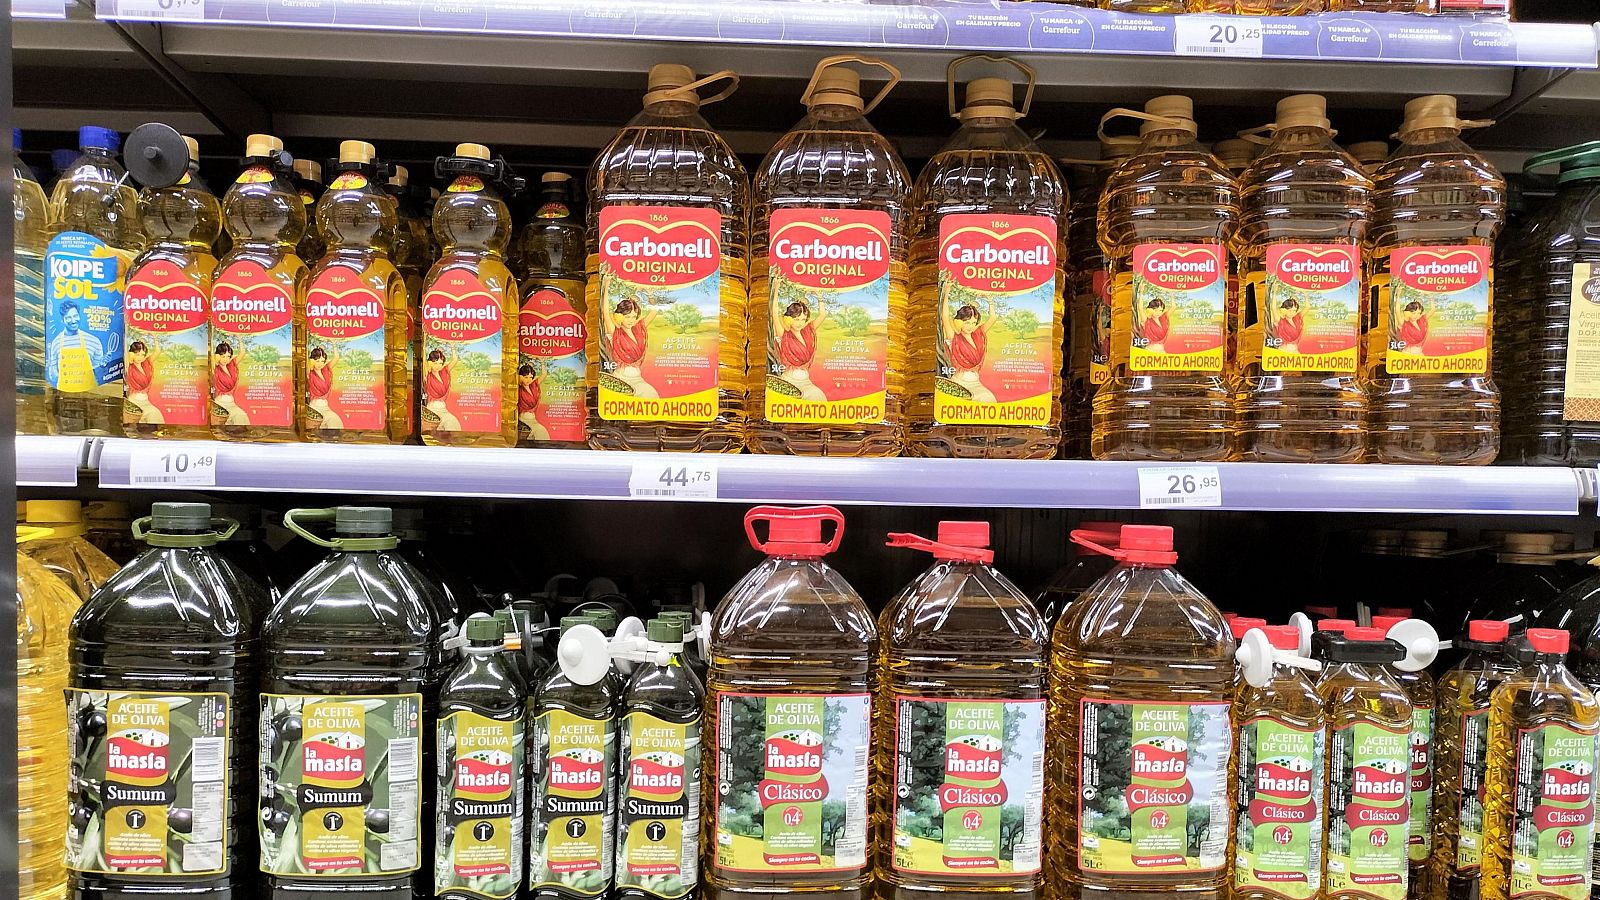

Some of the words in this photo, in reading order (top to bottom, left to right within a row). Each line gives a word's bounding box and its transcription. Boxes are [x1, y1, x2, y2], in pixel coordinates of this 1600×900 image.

[434, 5, 473, 14] Carrefour
[584, 10, 623, 19] Carrefour
[732, 16, 771, 25] Carrefour
[896, 21, 935, 30] Carrefour
[1042, 25, 1081, 34] Carrefour
[1330, 34, 1368, 43] Carrefour
[1472, 38, 1510, 47] Carrefour
[820, 216, 840, 224] 1866
[605, 236, 713, 259] Carbonell
[775, 238, 882, 261] Carbonell
[945, 243, 1050, 266] Carbonell
[50, 256, 105, 279] KOIPE
[622, 259, 695, 274] ORIGINAL
[792, 261, 865, 277] ORIGINAL
[1147, 259, 1216, 273] Carbonell
[1281, 259, 1350, 273] Carbonell
[1405, 260, 1478, 275] Carbonell
[963, 265, 1034, 281] ORIGINAL
[1159, 273, 1205, 283] ORIGINAL
[1293, 273, 1340, 283] ORIGINAL
[1417, 275, 1467, 285] ORIGINAL
[53, 277, 99, 301] SOL
[86, 313, 112, 324] 20%
[133, 311, 190, 323] ORIGINAL
[218, 312, 273, 324] ORIGINAL
[423, 304, 498, 321] Carbonell
[313, 317, 366, 328] ORIGINAL
[431, 320, 485, 331] ORIGINAL
[517, 322, 583, 338] arbonell
[522, 337, 573, 348] ORIGINAL
[1134, 356, 1180, 368] FORMATO
[1182, 356, 1220, 368] AHORRO
[1267, 356, 1315, 368] FORMATO
[1316, 356, 1354, 369] AHORRO
[1390, 358, 1440, 371] FORMATO
[1442, 358, 1484, 371] AHORRO
[603, 401, 659, 415] FORMATO
[662, 402, 712, 416] AHORRO
[770, 403, 827, 419] FORMATO
[829, 404, 879, 420] AHORRO
[940, 404, 996, 420] FORMATO
[999, 406, 1046, 421] AHORRO
[118, 703, 159, 714] ACEITE
[314, 707, 354, 717] ACEITE
[775, 703, 814, 713] ACEITE
[955, 708, 994, 718] ACEITE
[111, 714, 128, 725] DE
[130, 714, 166, 726] OLIVA
[768, 714, 785, 725] DE
[787, 714, 821, 725] OLIVA
[1141, 710, 1180, 720] ACEITE
[307, 718, 324, 728] DE
[326, 718, 361, 729] OLIVA
[560, 724, 595, 734] ACEITE
[949, 719, 966, 730] DE
[967, 719, 1001, 730] OLIVA
[1135, 721, 1152, 731] DE
[1153, 721, 1186, 732] OLIVA
[467, 726, 503, 735] ACEITE
[641, 727, 676, 737] ACEITE
[460, 736, 477, 746] DE
[478, 736, 509, 746] OLIVA
[553, 735, 570, 744] DE
[570, 735, 601, 745] OLIVA
[636, 737, 652, 747] DE
[653, 738, 682, 748] OLIVA
[1267, 732, 1304, 743] ACEITE
[1364, 736, 1399, 746] ACEITE
[1555, 738, 1587, 748] ACEITE
[109, 742, 120, 755] la
[305, 746, 317, 758] la
[767, 743, 779, 755] la
[948, 747, 959, 759] la
[1261, 743, 1276, 752] DE
[1279, 743, 1309, 753] OLIVA
[1358, 745, 1374, 755] DE
[1375, 746, 1404, 756] OLIVA
[1548, 747, 1563, 757] DE
[1565, 747, 1591, 757] OLIVA
[1134, 749, 1146, 761] la
[458, 763, 469, 774] la
[551, 761, 562, 773] la
[632, 763, 643, 774] la
[1258, 767, 1269, 779] la
[1355, 770, 1366, 782] la
[1545, 773, 1556, 784] la
[107, 785, 167, 802] Sumum
[304, 788, 363, 803] Sumum
[764, 783, 823, 800] Clásico
[943, 787, 1002, 804] Clásico
[1131, 788, 1187, 804] Clásico
[453, 800, 513, 816] Sumum
[547, 797, 605, 813] Sumum
[628, 801, 684, 816] Sumum
[1262, 806, 1305, 819] Clásico
[1359, 809, 1400, 821] Clásico
[1547, 811, 1585, 824] Clásico
